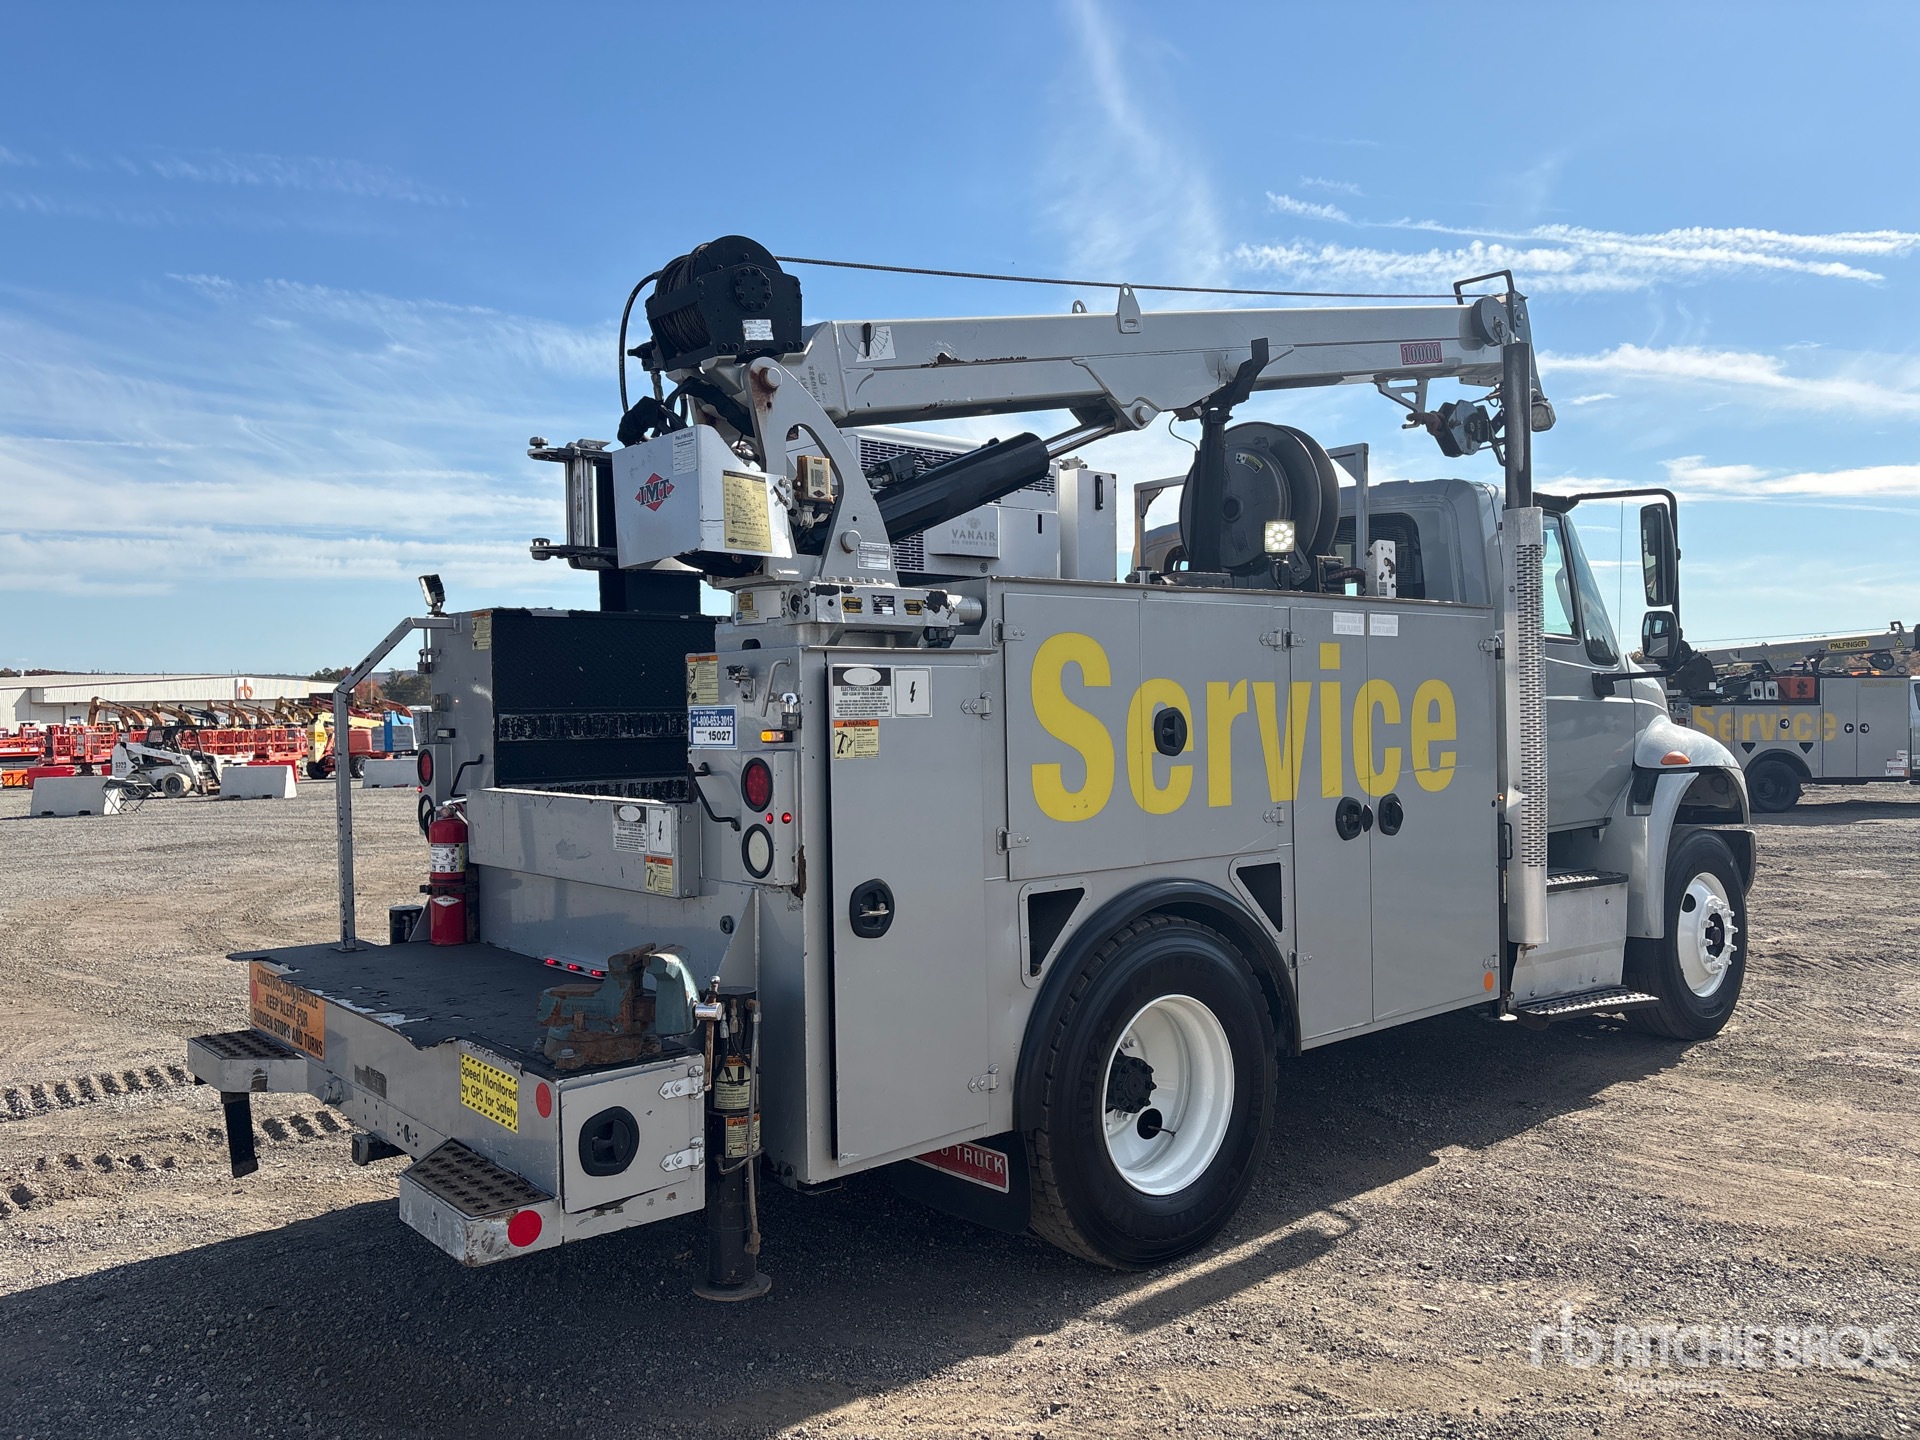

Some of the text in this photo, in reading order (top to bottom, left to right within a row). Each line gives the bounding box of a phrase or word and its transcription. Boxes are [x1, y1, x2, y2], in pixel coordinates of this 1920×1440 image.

[1402, 344, 1440, 363] 10000
[639, 478, 670, 506] IMT
[951, 528, 996, 541] VANAIR
[1830, 640, 1867, 649] PALFINGER
[238, 679, 253, 700] rb
[696, 716, 733, 726] 1-800-653-3015
[708, 730, 731, 741] 15027
[1031, 632, 1457, 822] Service
[1692, 705, 1836, 742] Service
[266, 993, 308, 1027] KEEP ALERT FOR
[253, 1008, 323, 1056] SUDDEN STOPS AND TURNS
[461, 1062, 518, 1101] Speed Monitored
[461, 1079, 517, 1123] by GPS for Safety
[955, 1145, 1003, 1175] TRUCK
